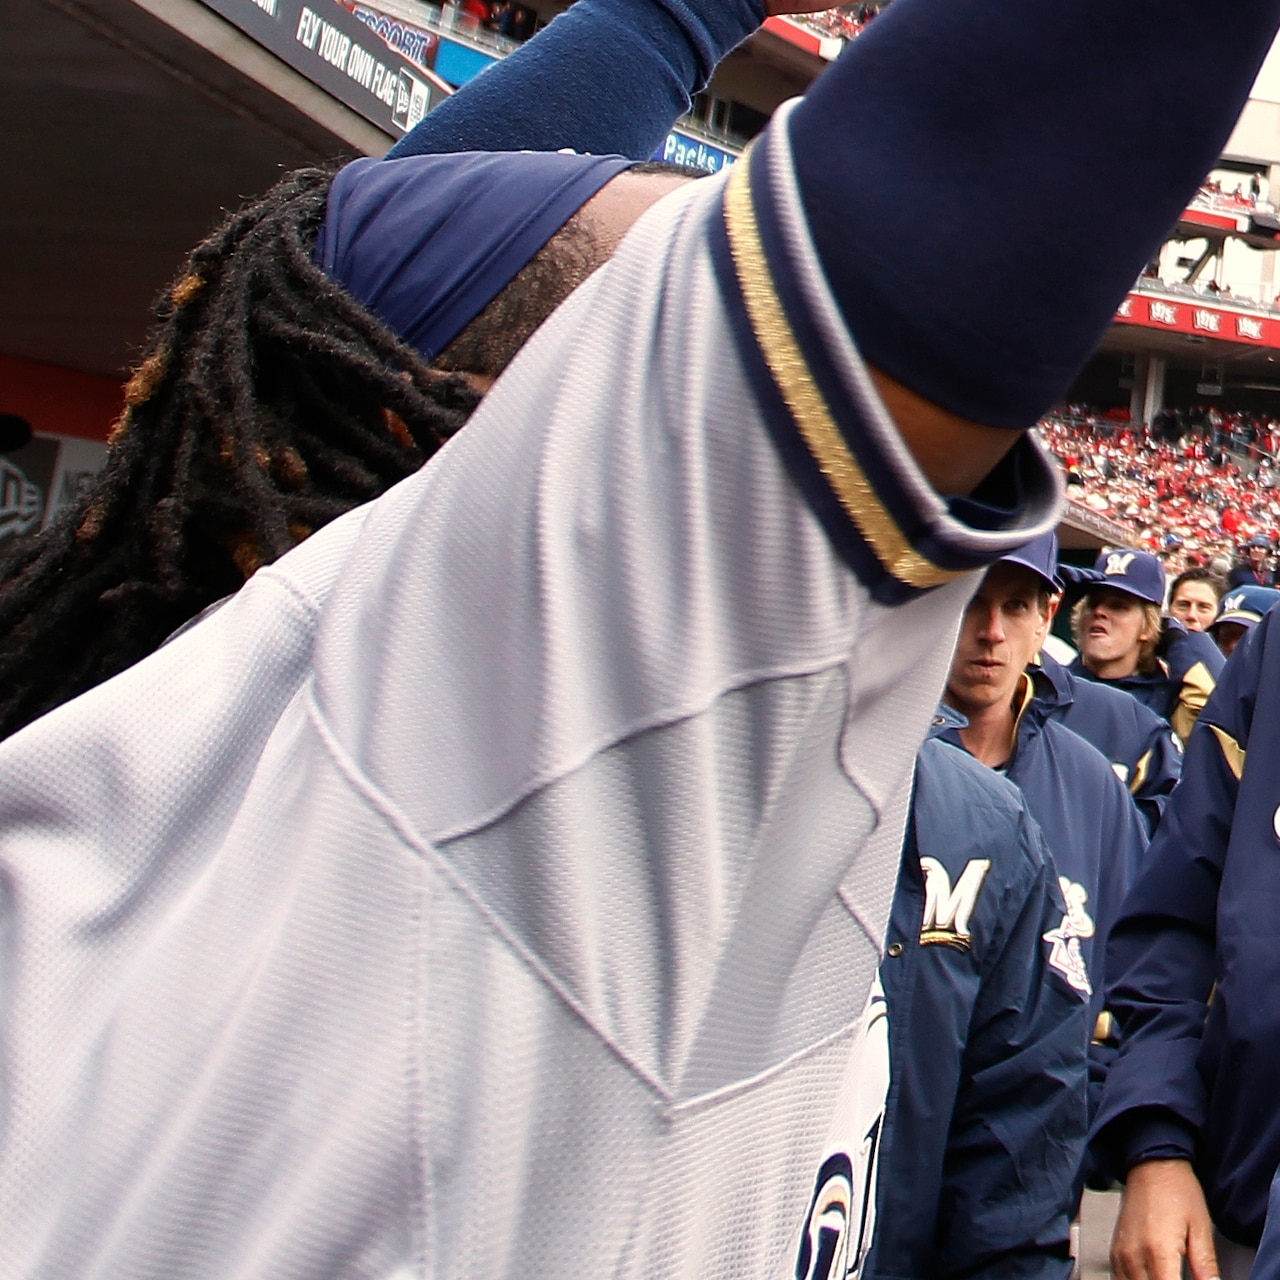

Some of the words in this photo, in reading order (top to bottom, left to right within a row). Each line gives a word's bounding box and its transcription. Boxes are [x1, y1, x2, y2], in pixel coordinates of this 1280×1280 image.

[296, 6, 322, 52] FLY
[318, 21, 350, 72] YOUR
[347, 43, 376, 90] OWN
[370, 62, 399, 107] FLAG
[663, 133, 716, 172] Packs
[919, 856, 991, 938] M
